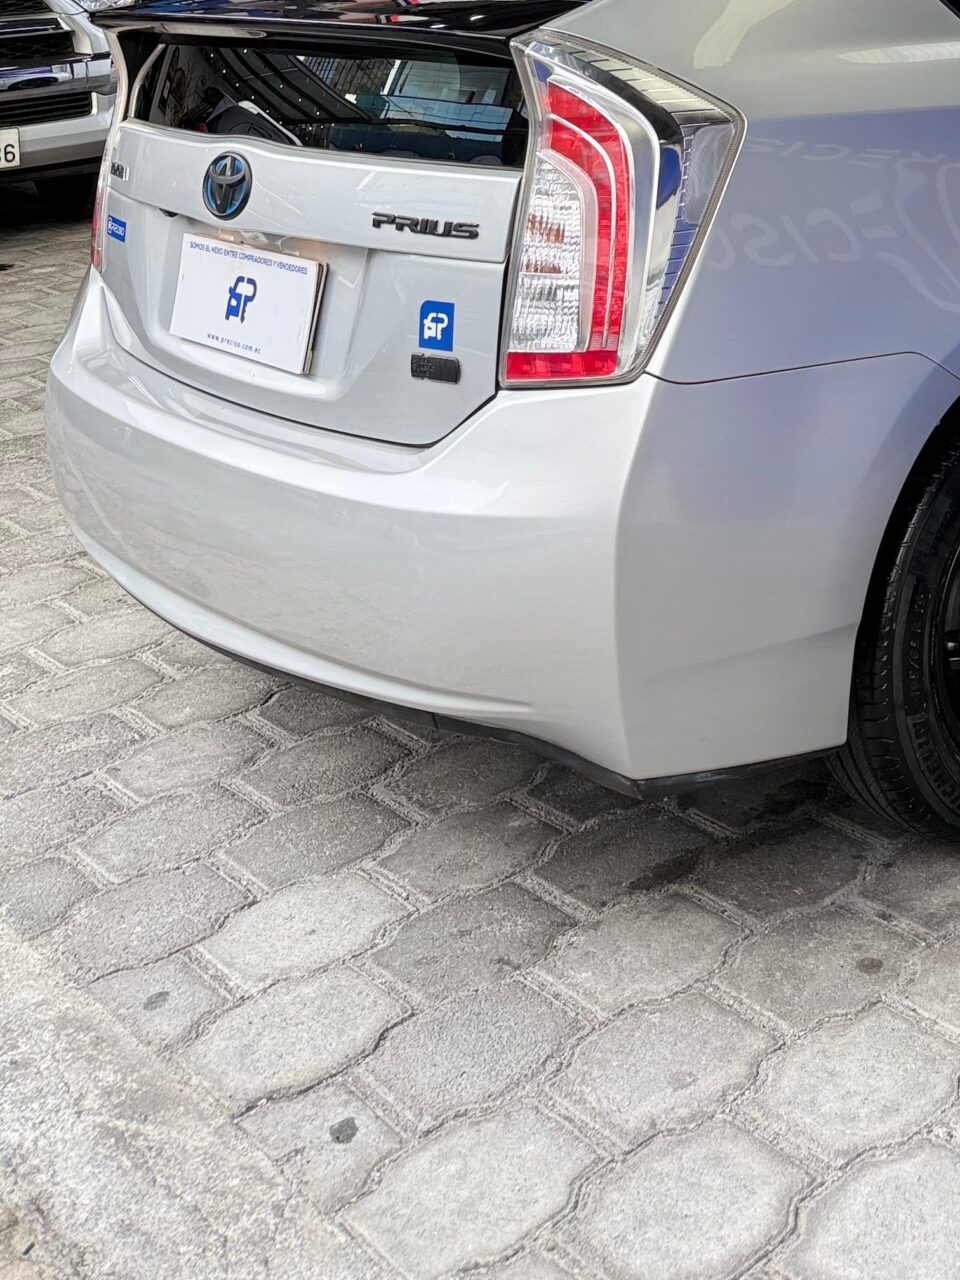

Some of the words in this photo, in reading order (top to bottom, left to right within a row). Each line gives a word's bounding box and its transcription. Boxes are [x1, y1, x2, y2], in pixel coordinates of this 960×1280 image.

[0, 144, 16, 163] 6
[371, 211, 480, 240] PRIUS
[189, 241, 205, 251] SOMOS
[205, 245, 211, 253] EL
[211, 246, 223, 256] NEXO
[223, 249, 238, 259] ENTRE
[238, 253, 273, 267] COMPRADORES
[277, 262, 308, 275] VENDEDORES
[207, 332, 262, 355] www.preciso.com.ec
